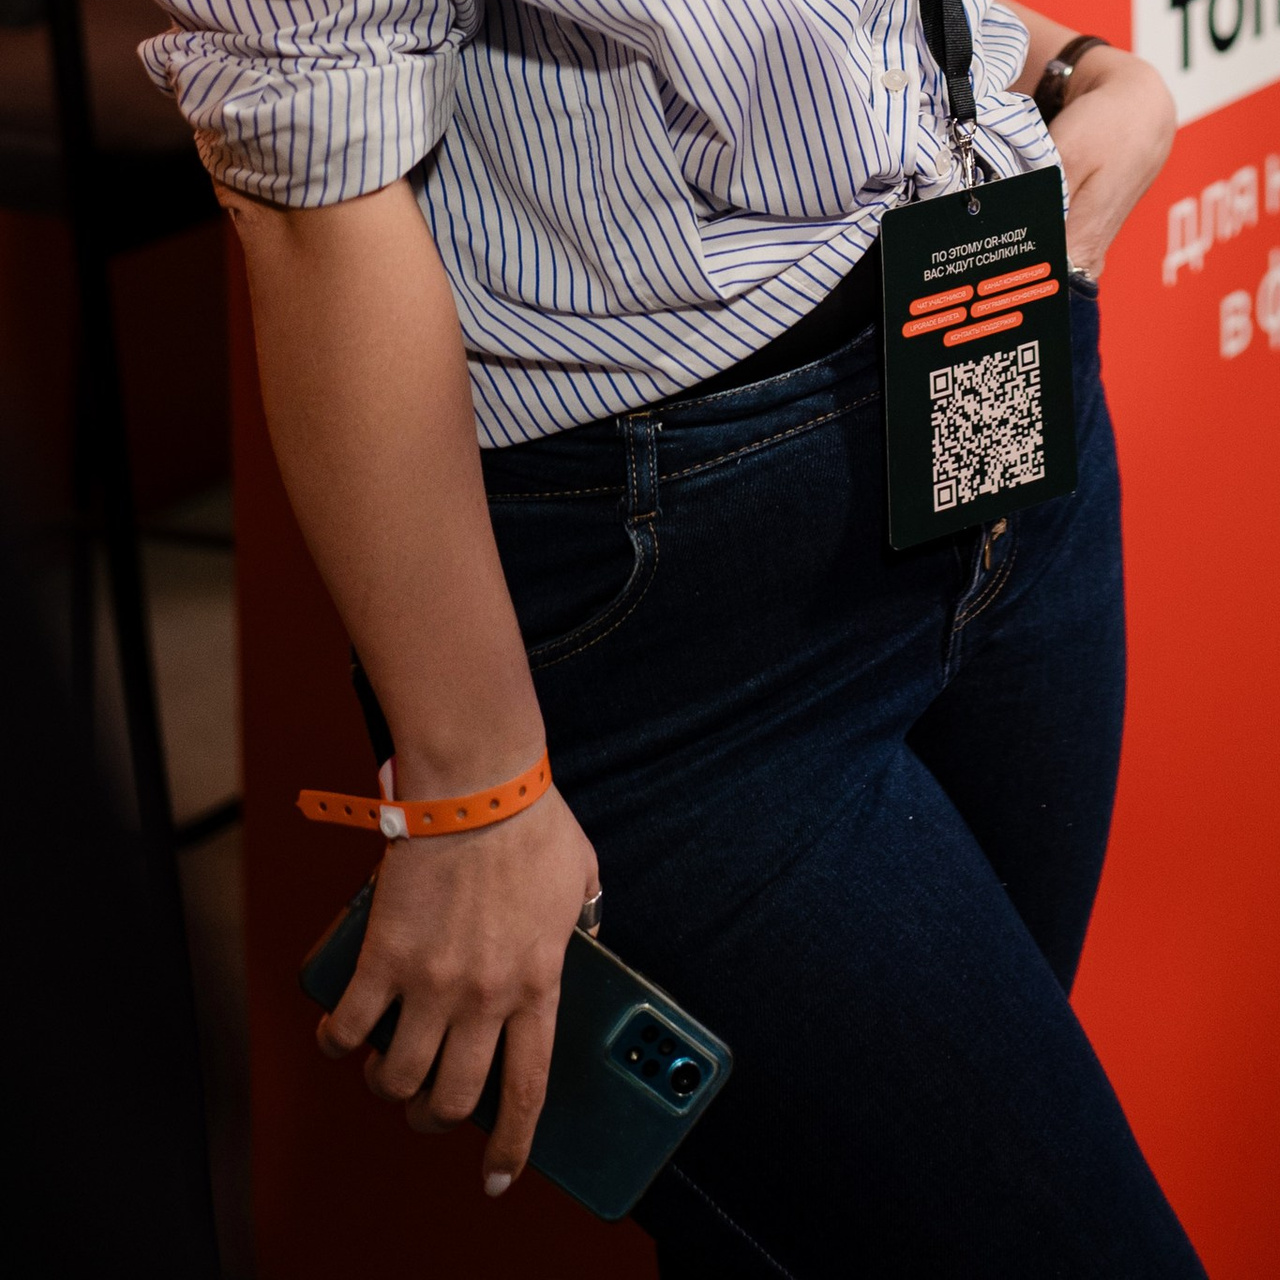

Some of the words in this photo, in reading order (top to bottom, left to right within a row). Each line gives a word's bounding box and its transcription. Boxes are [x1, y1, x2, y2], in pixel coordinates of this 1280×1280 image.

[931, 250, 948, 265] ПО
[948, 239, 983, 260] ЭТОМУ
[983, 226, 1028, 250] QR-КОДУ
[1162, 165, 1259, 287] для
[923, 266, 945, 282] ВАС
[945, 257, 975, 276] ЖДУТ
[975, 244, 1019, 267] ССЫЛКИ
[1019, 240, 1037, 255] НА:
[1003, 267, 1045, 284] КОНФЕРЕНЦИИ
[916, 301, 929, 310] ЧАТ
[929, 290, 967, 308] УЧАСТНИКОВ
[1011, 284, 1054, 301] КОНФЕРЕНЦИИ
[1219, 289, 1253, 360] в
